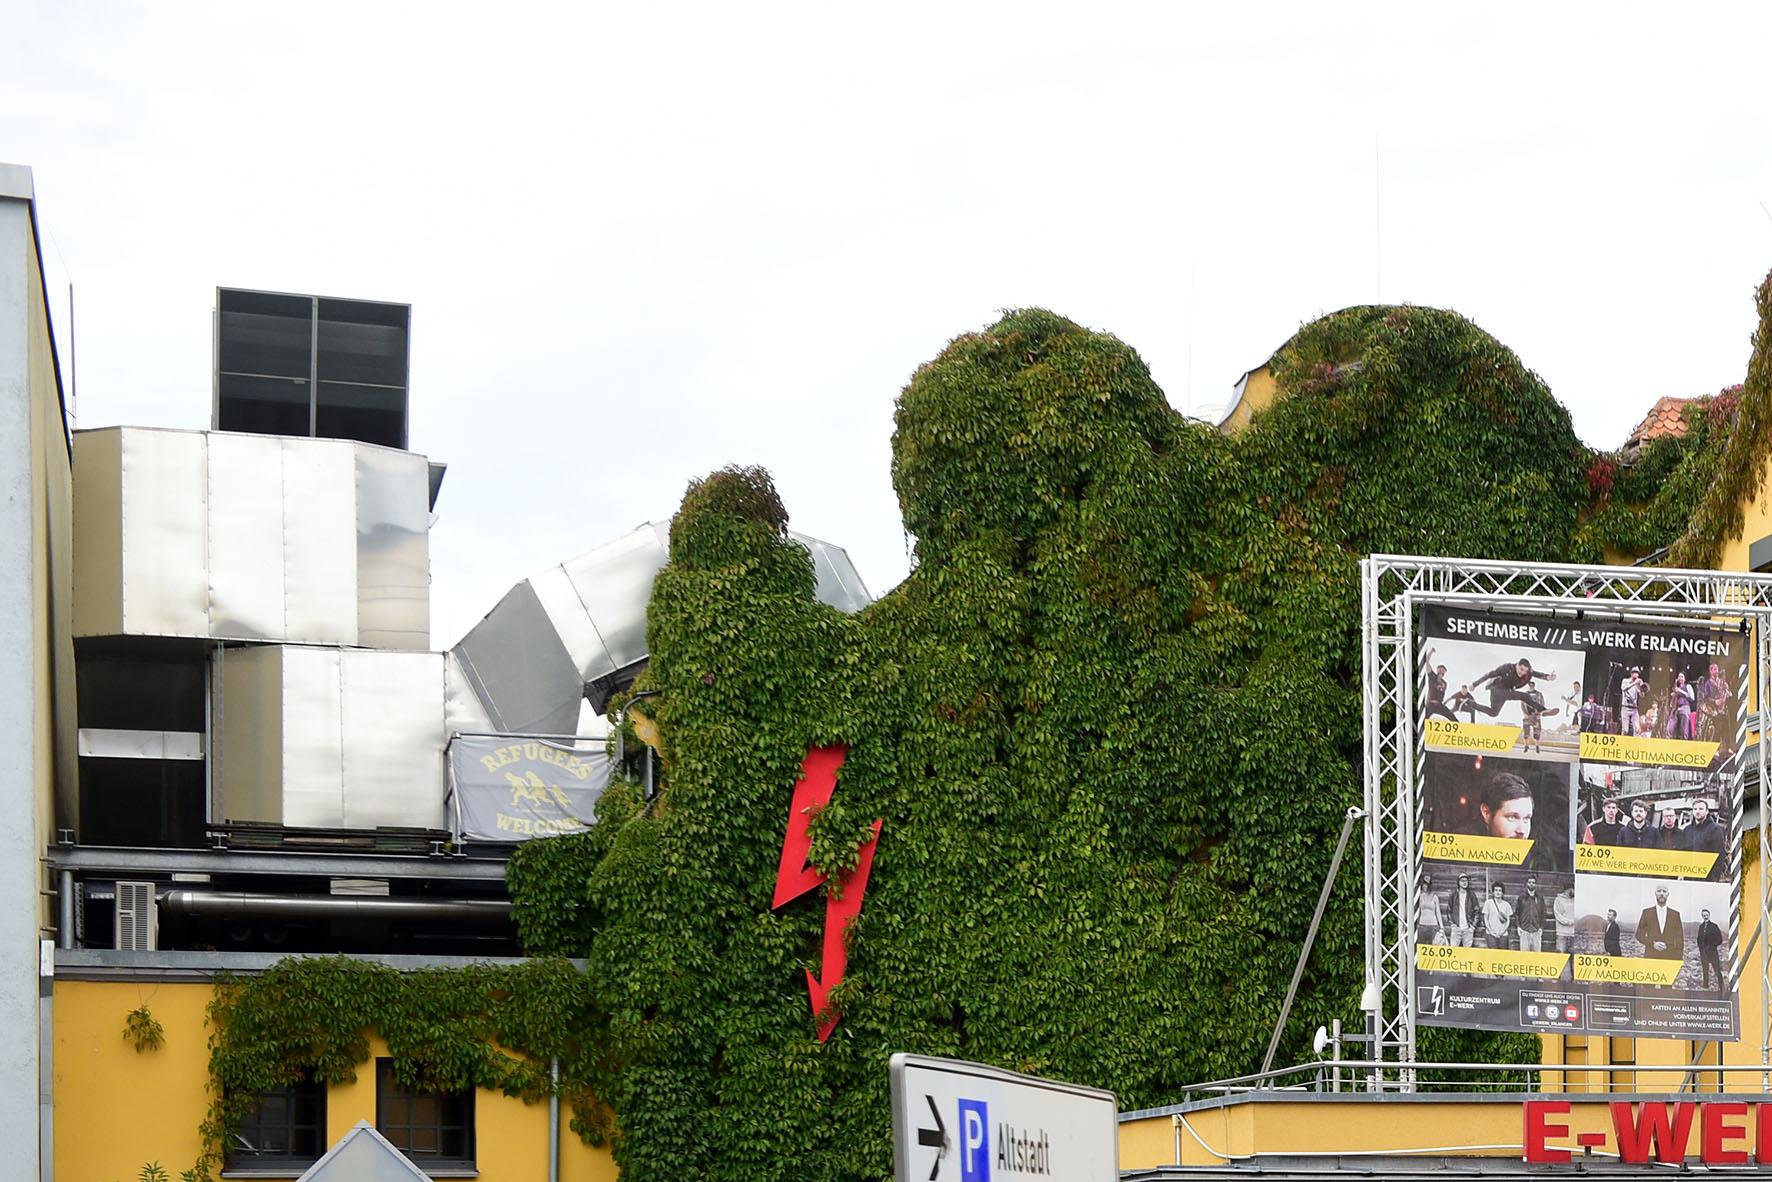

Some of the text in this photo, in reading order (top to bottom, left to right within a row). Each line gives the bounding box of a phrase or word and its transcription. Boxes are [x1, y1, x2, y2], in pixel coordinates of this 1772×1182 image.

[1447, 617, 1538, 642] SEPTEMBER
[1572, 630, 1635, 650] E-WERK
[1640, 635, 1730, 657] ERLANGEN
[1428, 721, 1462, 734] 12.09.
[1444, 734, 1507, 750] ZEBRAHEAD
[1585, 734, 1619, 747] 14.09.
[480, 742, 593, 780] REFUGEES
[1601, 747, 1622, 759] THE
[1624, 749, 1707, 765] KUTIMANGOES
[496, 813, 583, 835] WELCOME
[1425, 833, 1458, 846] 24.09.
[1440, 846, 1465, 858] DAN
[1467, 850, 1520, 862] MANGAN
[1579, 847, 1614, 859] 26.09.
[1591, 859, 1604, 868] WE
[1606, 860, 1627, 869] WERE
[1629, 862, 1670, 872] PROMISED
[1670, 865, 1709, 875] JETPACKS
[1421, 946, 1457, 959] 26.09.
[1439, 959, 1474, 971] DICHT
[1477, 962, 1485, 972] &
[1491, 962, 1558, 977] ERGREIFEND
[1578, 955, 1613, 968] 30.09.
[1595, 969, 1668, 983] MADRUGADA
[1449, 995, 1501, 1004] KULTURZENTRUM
[965, 1109, 1052, 1177] P Altstadt
